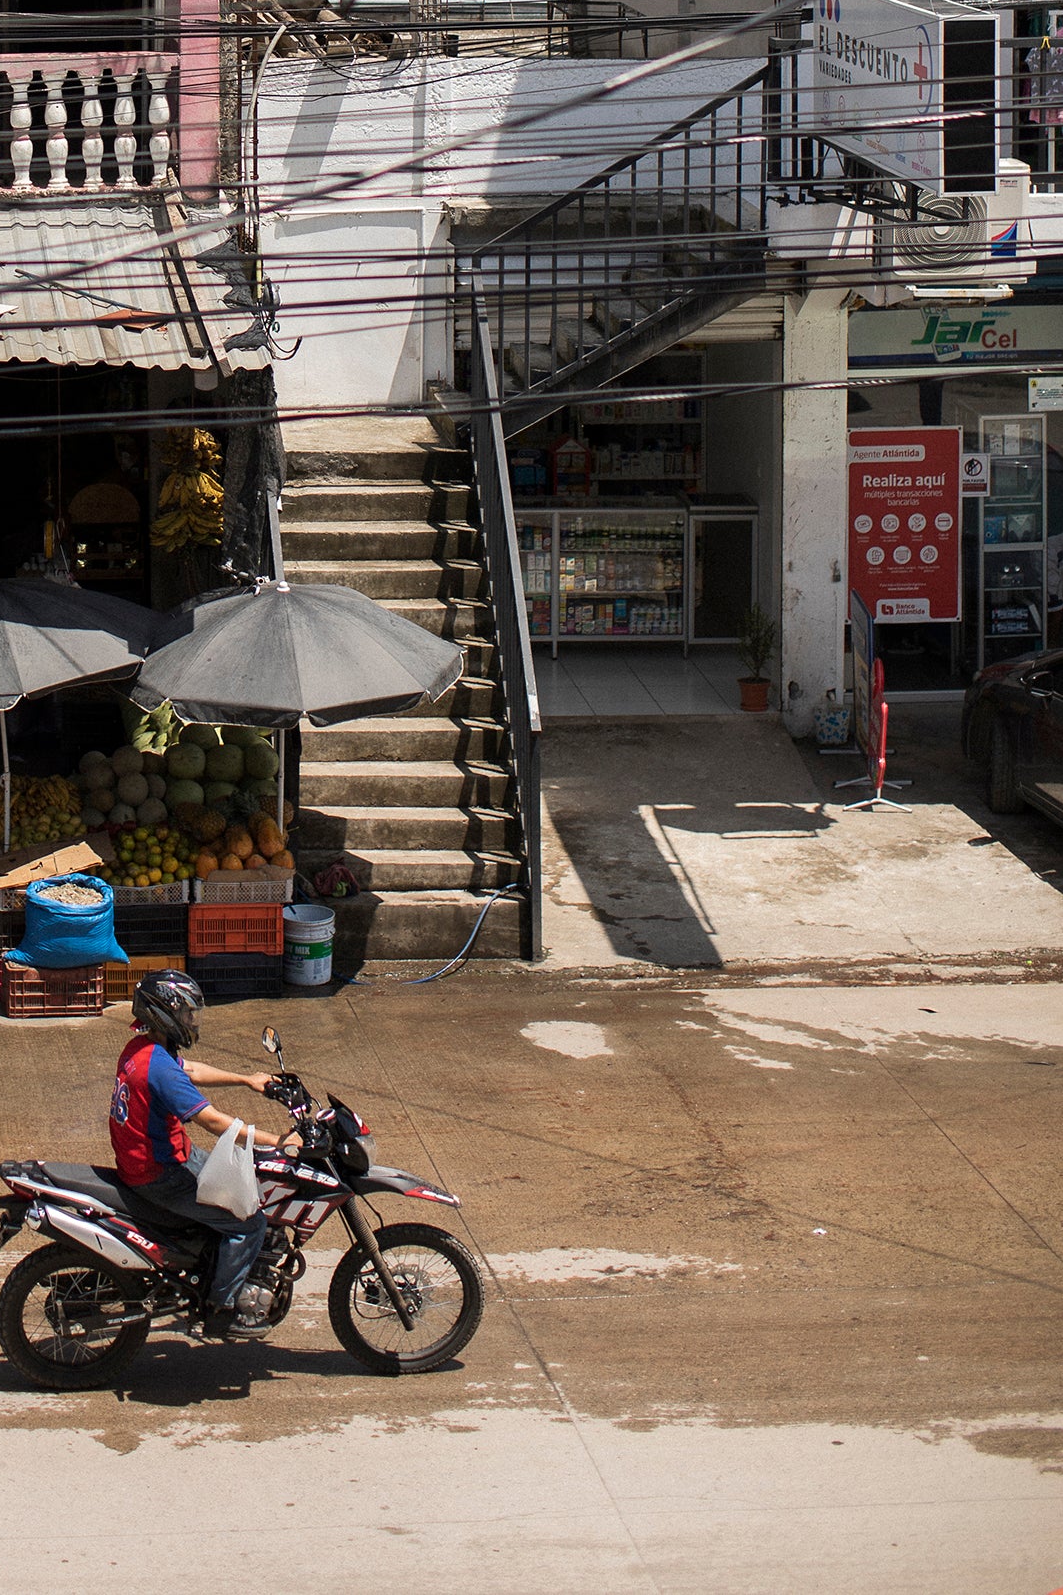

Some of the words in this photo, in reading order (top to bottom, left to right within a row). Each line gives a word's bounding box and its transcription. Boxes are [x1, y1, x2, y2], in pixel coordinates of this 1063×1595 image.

[819, 25, 832, 55] EL
[837, 31, 908, 83] DESCUENTO
[819, 59, 852, 84] VARIEDADES
[981, 329, 1017, 349] Cel
[853, 450, 881, 460] Agente
[882, 449, 920, 458] Atlántida
[863, 474, 912, 487] Realiza
[916, 472, 946, 488] aquí
[887, 498, 920, 507] bancarias
[897, 489, 943, 498] transacciones
[258, 1160, 339, 1188] GENESIS
[127, 1230, 155, 1250] 150
